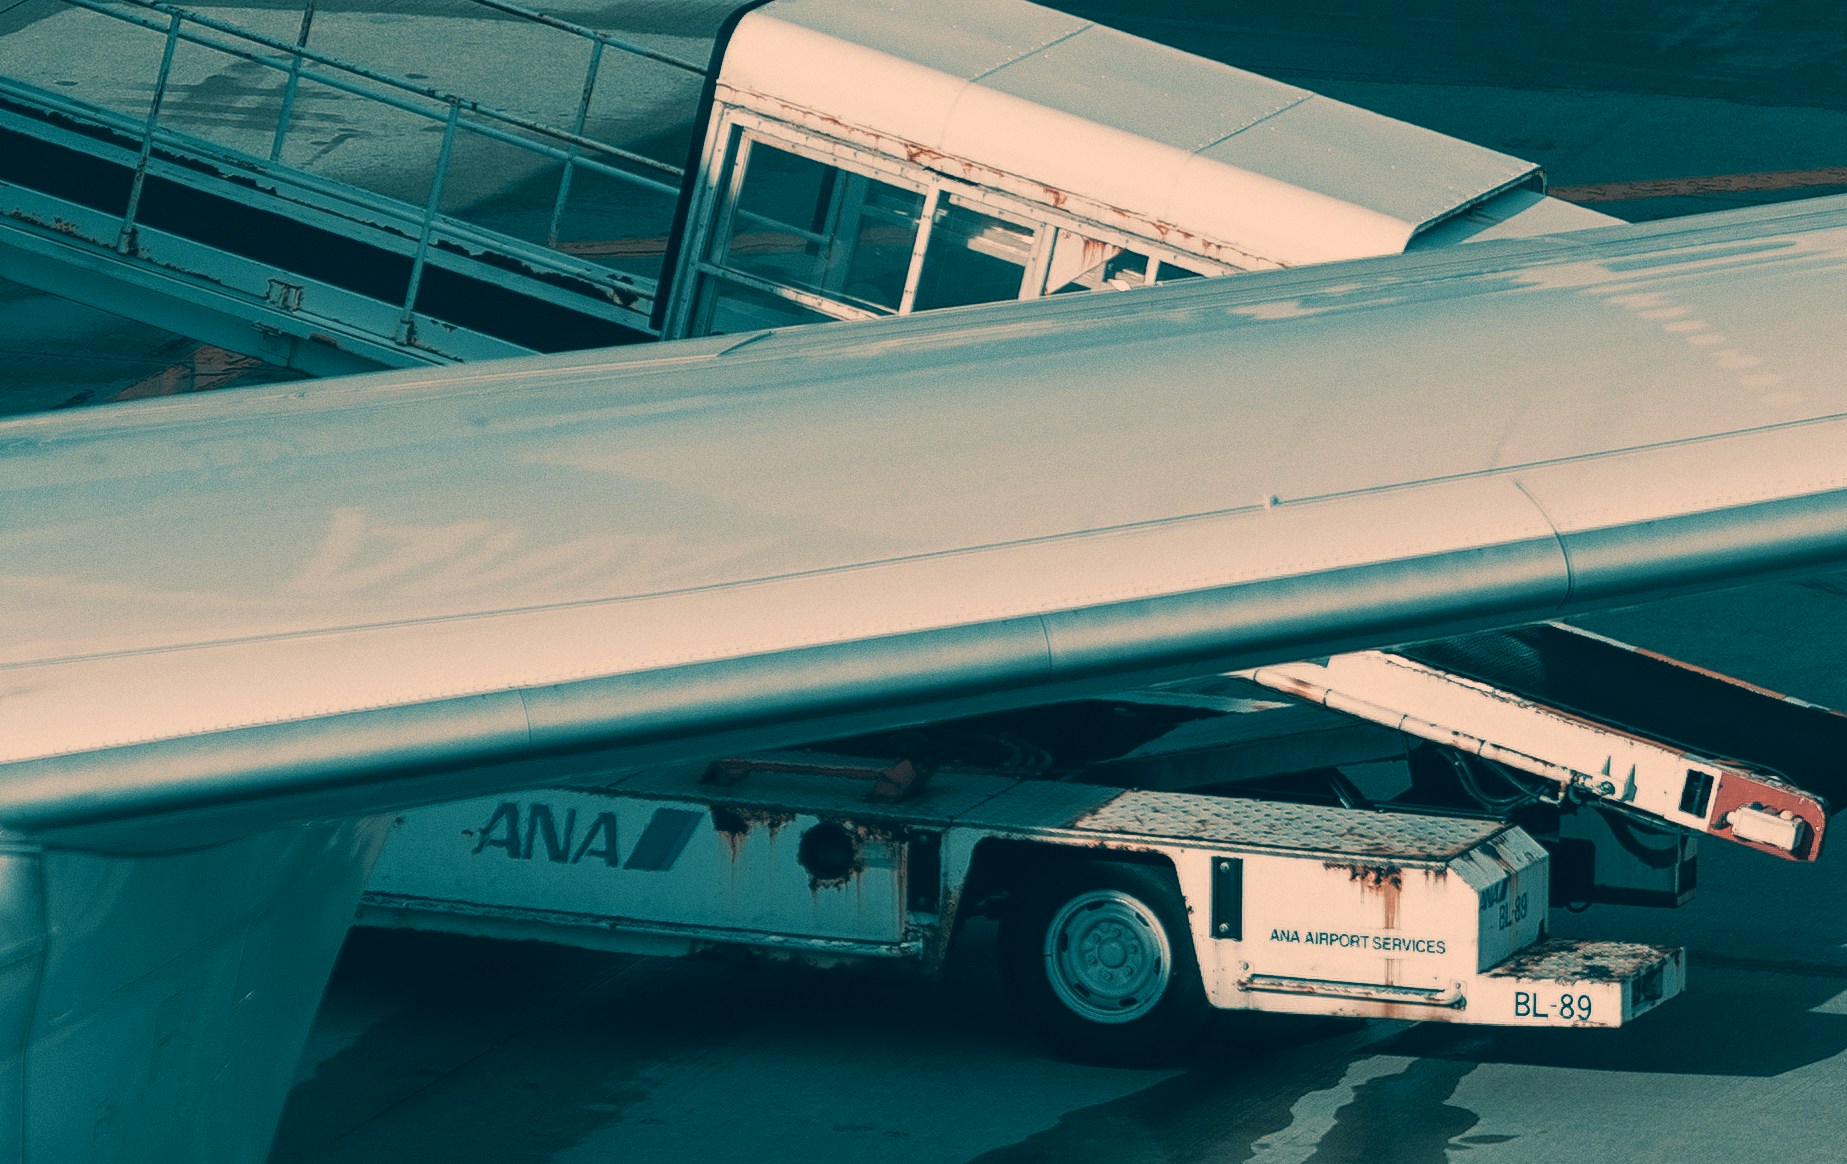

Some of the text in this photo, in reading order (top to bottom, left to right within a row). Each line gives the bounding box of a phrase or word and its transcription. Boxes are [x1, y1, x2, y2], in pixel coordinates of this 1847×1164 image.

[472, 801, 619, 868] ANA
[1270, 928, 1446, 955] ANA AIRPORT SERVICES
[1515, 991, 1592, 1022] BL-89
